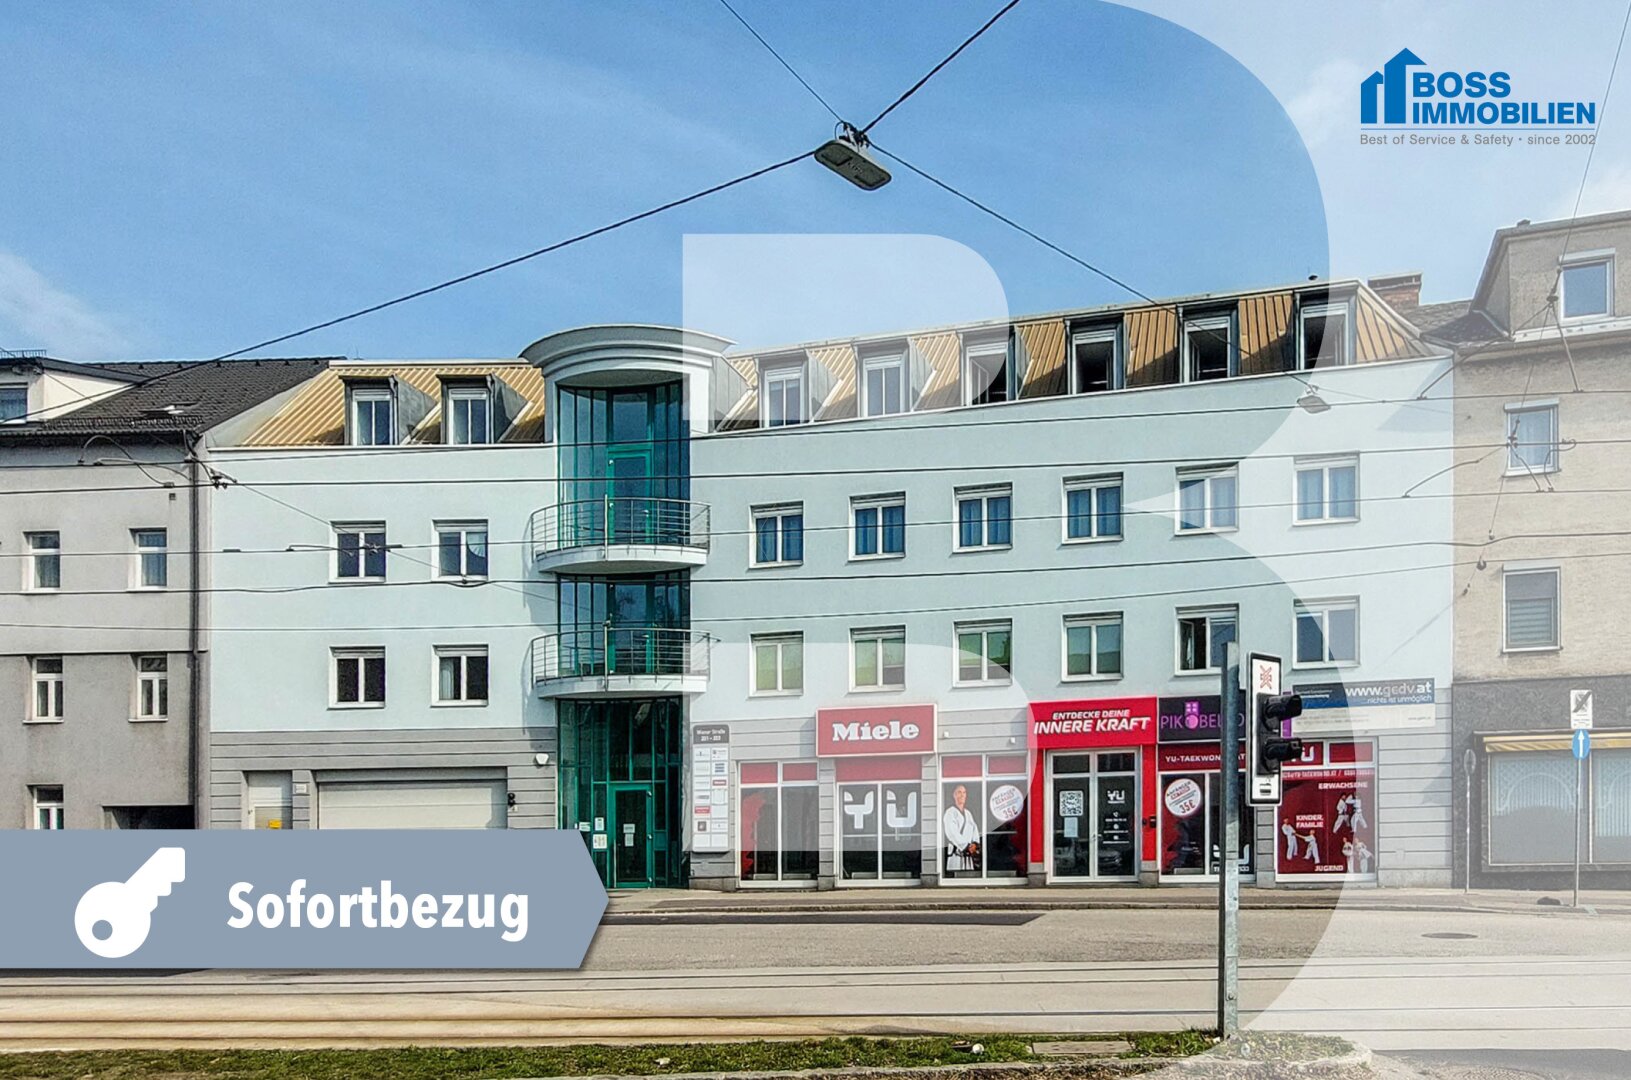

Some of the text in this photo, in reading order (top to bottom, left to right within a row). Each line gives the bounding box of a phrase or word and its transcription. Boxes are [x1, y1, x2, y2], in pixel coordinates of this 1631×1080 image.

[1052, 709, 1130, 720] ENTDECKE DEINE
[832, 720, 920, 742] Miele
[1033, 716, 1152, 735] INNERE KRAFT
[1296, 821, 1324, 829] FAMILIE
[1314, 864, 1344, 872] JUGEND
